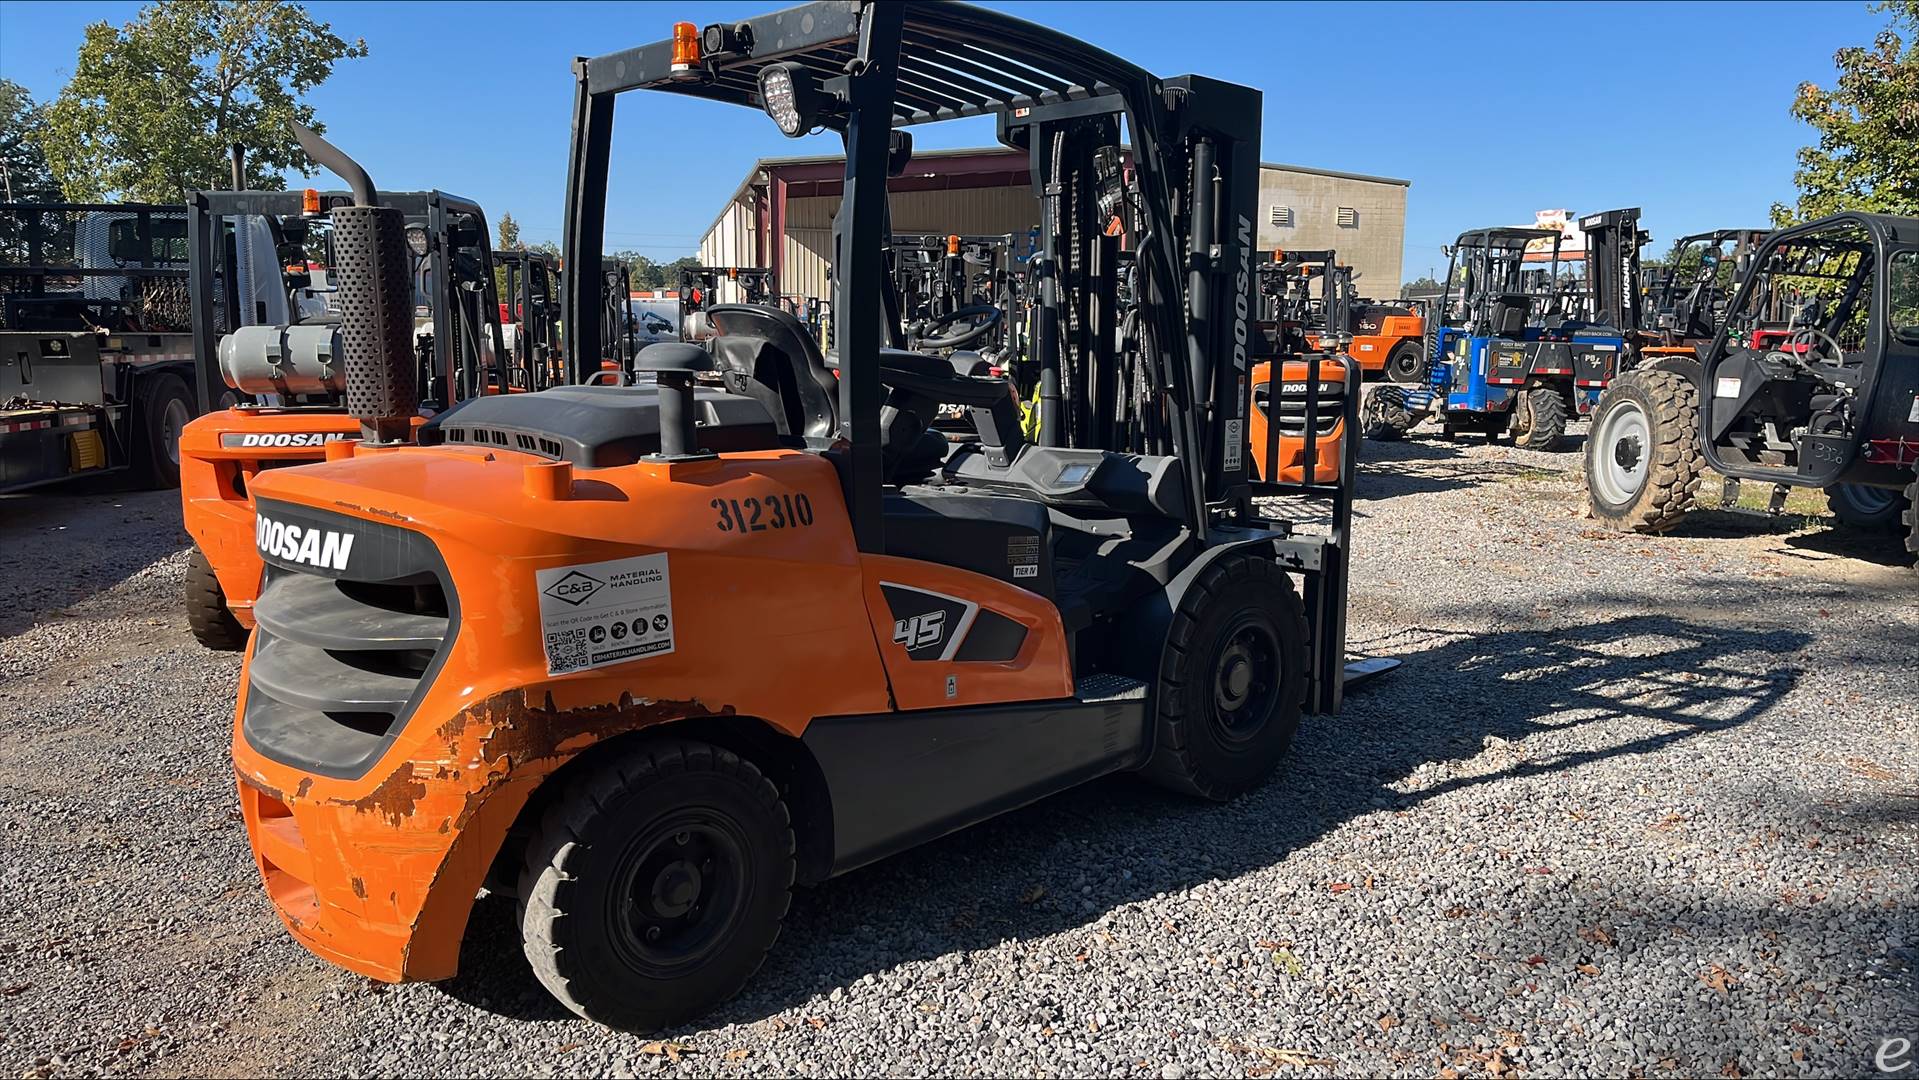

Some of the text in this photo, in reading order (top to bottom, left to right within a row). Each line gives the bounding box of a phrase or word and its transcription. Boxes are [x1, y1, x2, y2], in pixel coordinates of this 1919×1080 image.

[1233, 213, 1252, 372] DOOSAN
[1281, 383, 1329, 393] DOON
[711, 493, 814, 533] 312310
[256, 513, 355, 571] DOOSAN
[610, 568, 661, 582] MATERIAL
[1015, 567, 1029, 576] TIER
[557, 581, 594, 596] C&B
[610, 575, 663, 589] HANDLING
[570, 617, 579, 625] QR
[580, 615, 593, 623] Code
[599, 612, 609, 620] Get
[893, 610, 946, 651] 45
